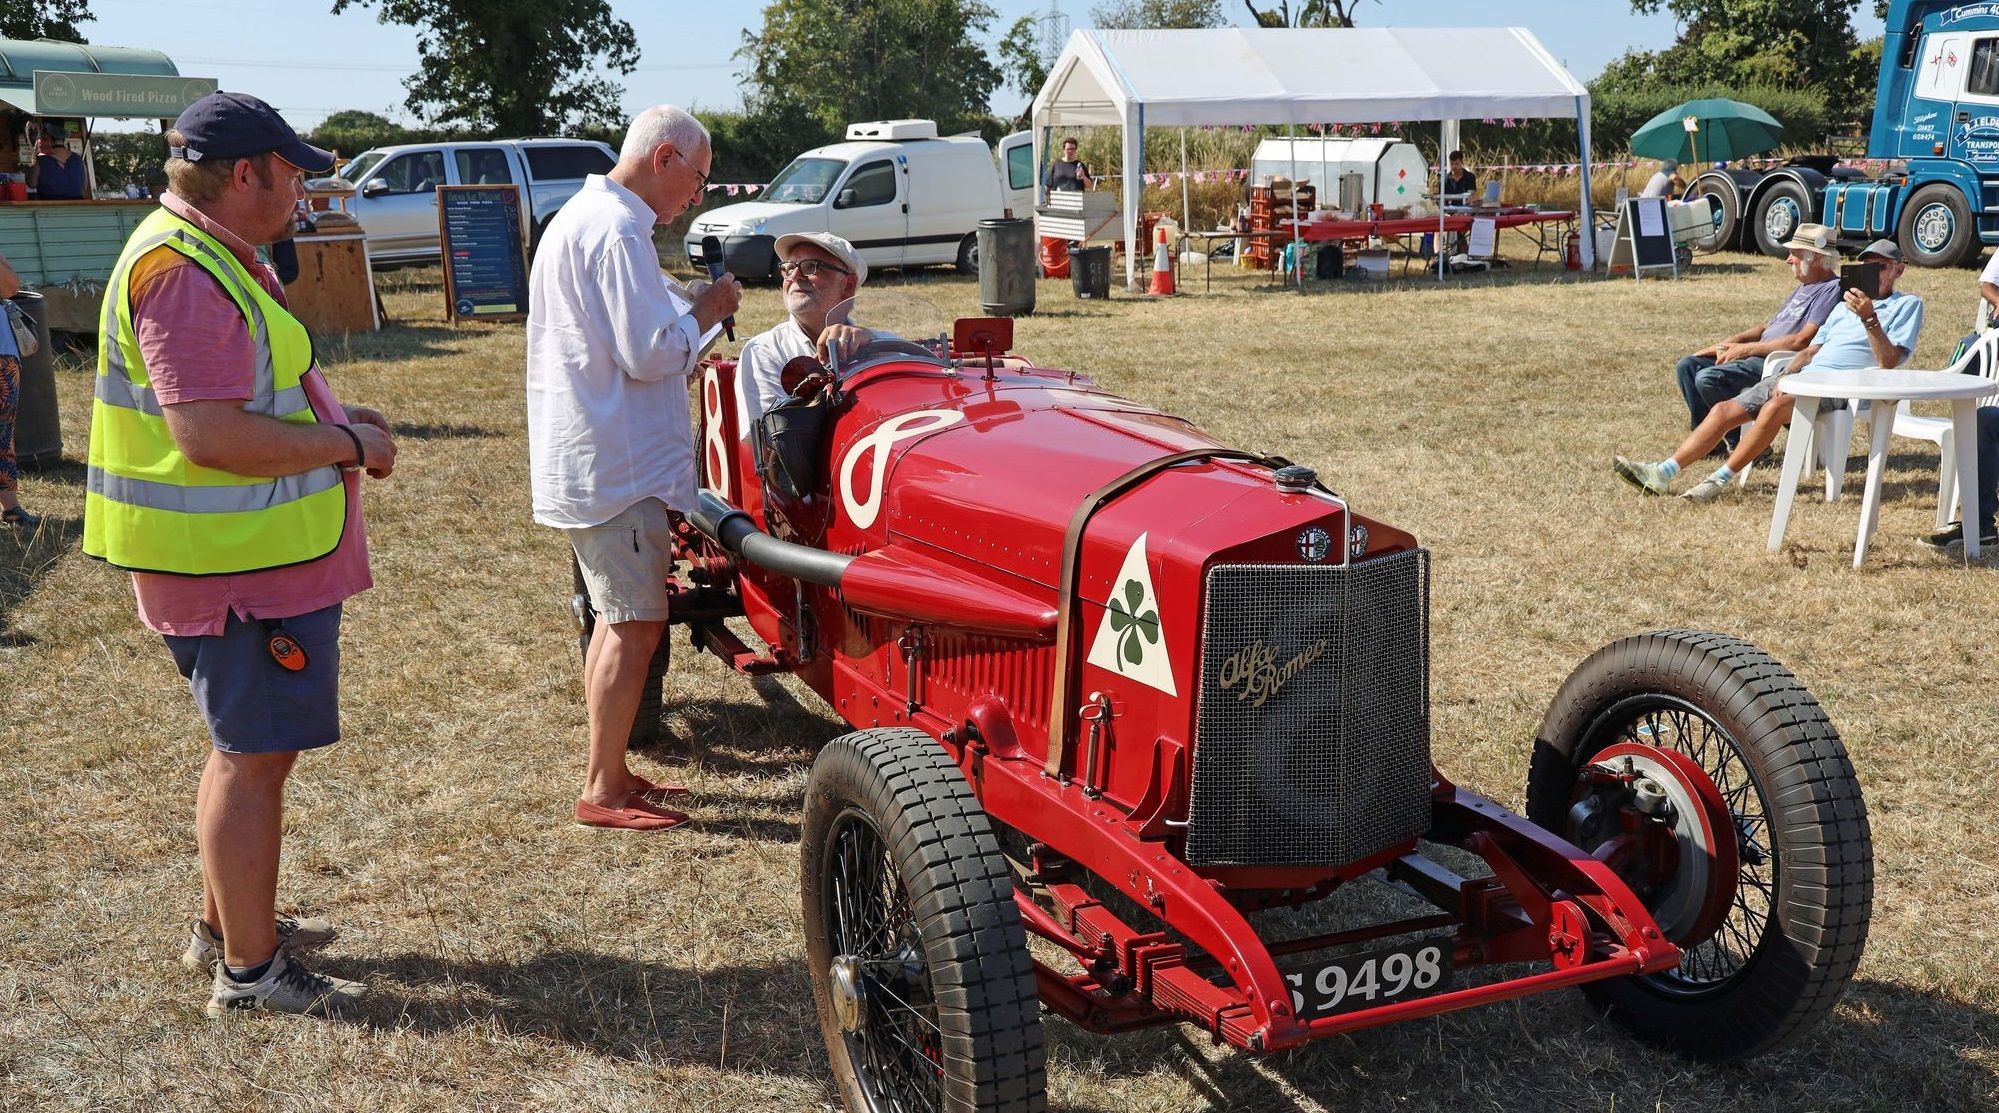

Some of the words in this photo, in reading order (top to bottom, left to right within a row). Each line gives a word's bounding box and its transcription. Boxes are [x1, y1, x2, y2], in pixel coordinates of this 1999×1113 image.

[1955, 4, 1988, 18] Cummins
[81, 88, 113, 101] Wood
[116, 90, 145, 103] Fired
[149, 91, 177, 104] Pizza
[1967, 141, 1999, 149] TRANSPO
[704, 367, 729, 500] 8
[839, 409, 965, 529] 8
[1302, 553, 1326, 562] MILANO
[1220, 639, 1280, 701] Alfa
[1248, 639, 1328, 707] Romeo
[1315, 946, 1441, 1011] 9498
